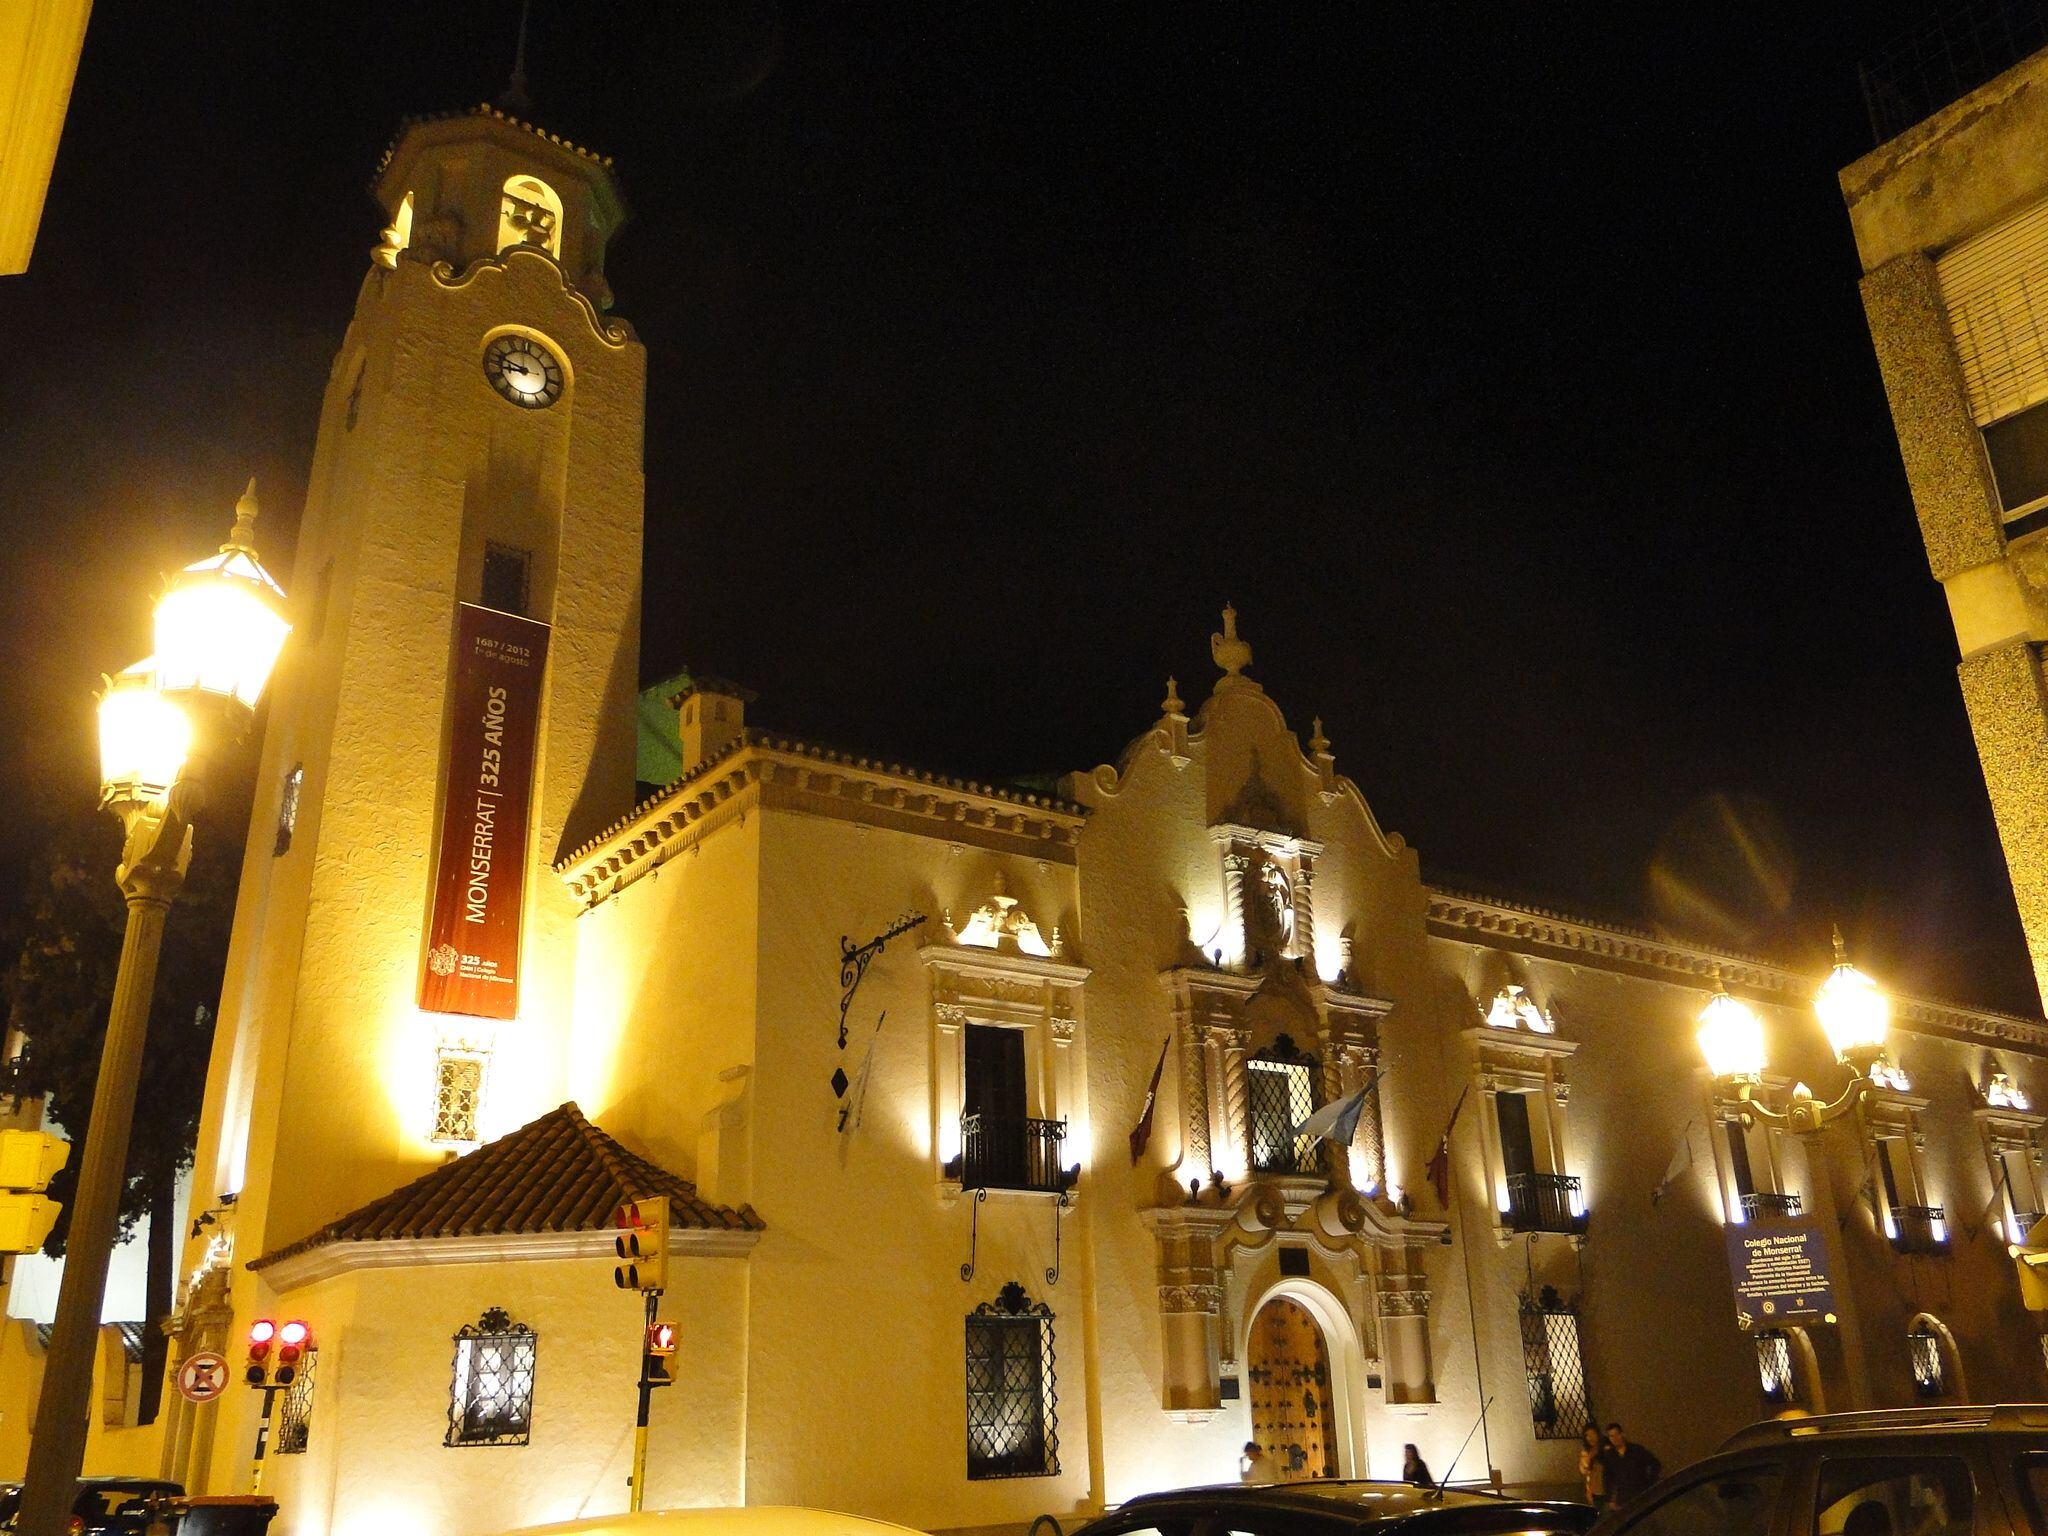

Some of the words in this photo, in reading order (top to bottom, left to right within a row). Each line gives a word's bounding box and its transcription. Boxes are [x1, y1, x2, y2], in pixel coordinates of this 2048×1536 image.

[476, 637, 499, 648] 1687
[506, 645, 530, 657] 2012
[485, 650, 497, 658] de
[499, 654, 529, 667] agosto
[482, 686, 507, 747] AÑOS
[481, 748, 501, 787] 325
[465, 797, 496, 924] MONSERRAT
[461, 954, 480, 966] 325
[1744, 1238, 1772, 1248] Colegio
[1773, 1234, 1807, 1245] Nacional
[1752, 1249, 1762, 1257] de
[1763, 1245, 1802, 1256] Monserrat
